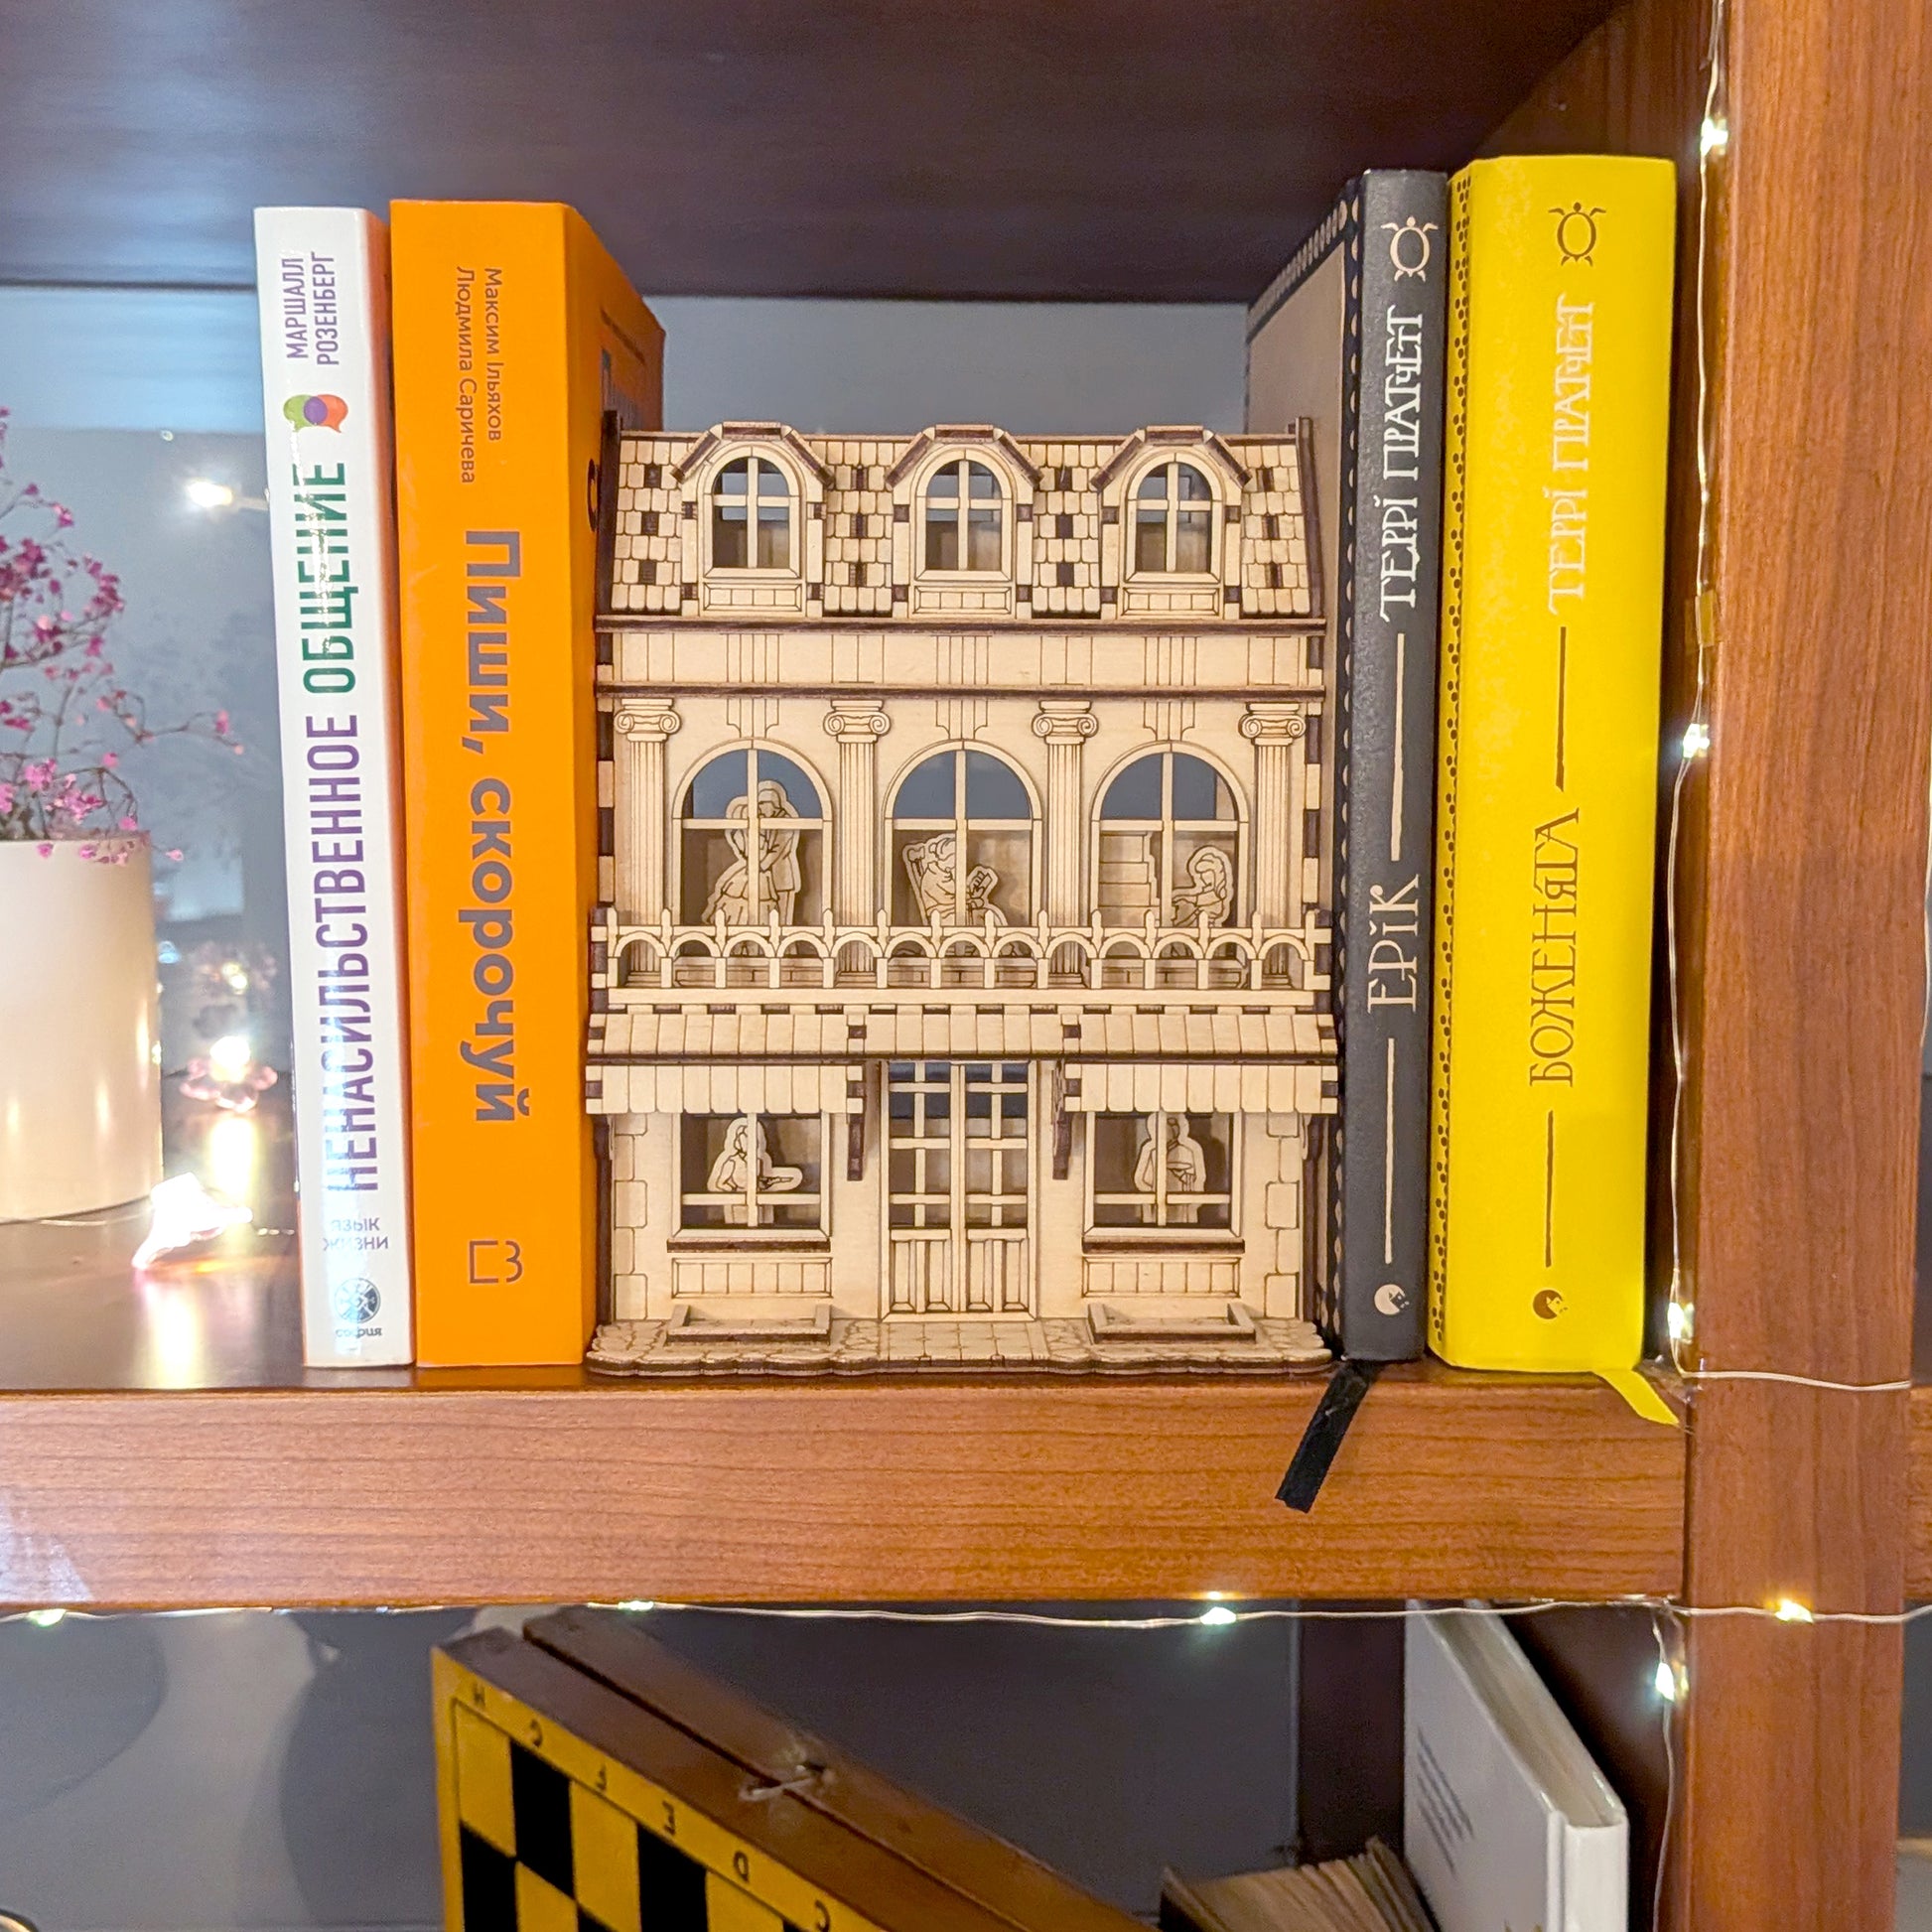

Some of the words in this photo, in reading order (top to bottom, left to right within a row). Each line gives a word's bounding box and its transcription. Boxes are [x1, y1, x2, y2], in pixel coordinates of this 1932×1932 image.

[282, 257, 309, 359] МАРШАЛЛ
[312, 251, 340, 366] РОЗЕНБЕРГ
[456, 265, 477, 372] Людмила
[484, 267, 503, 355] Максим
[457, 378, 478, 483] Саричева
[485, 362, 505, 441] Ільяхов
[292, 463, 358, 693] ОБЩЕНИЕ
[462, 530, 521, 755] Пиши,
[306, 715, 378, 1191] НЕНАСИЛЬСТВЕННОЕ
[459, 777, 530, 1122] скорочуй
[1529, 807, 1581, 1088] БОЖЕНЯТА
